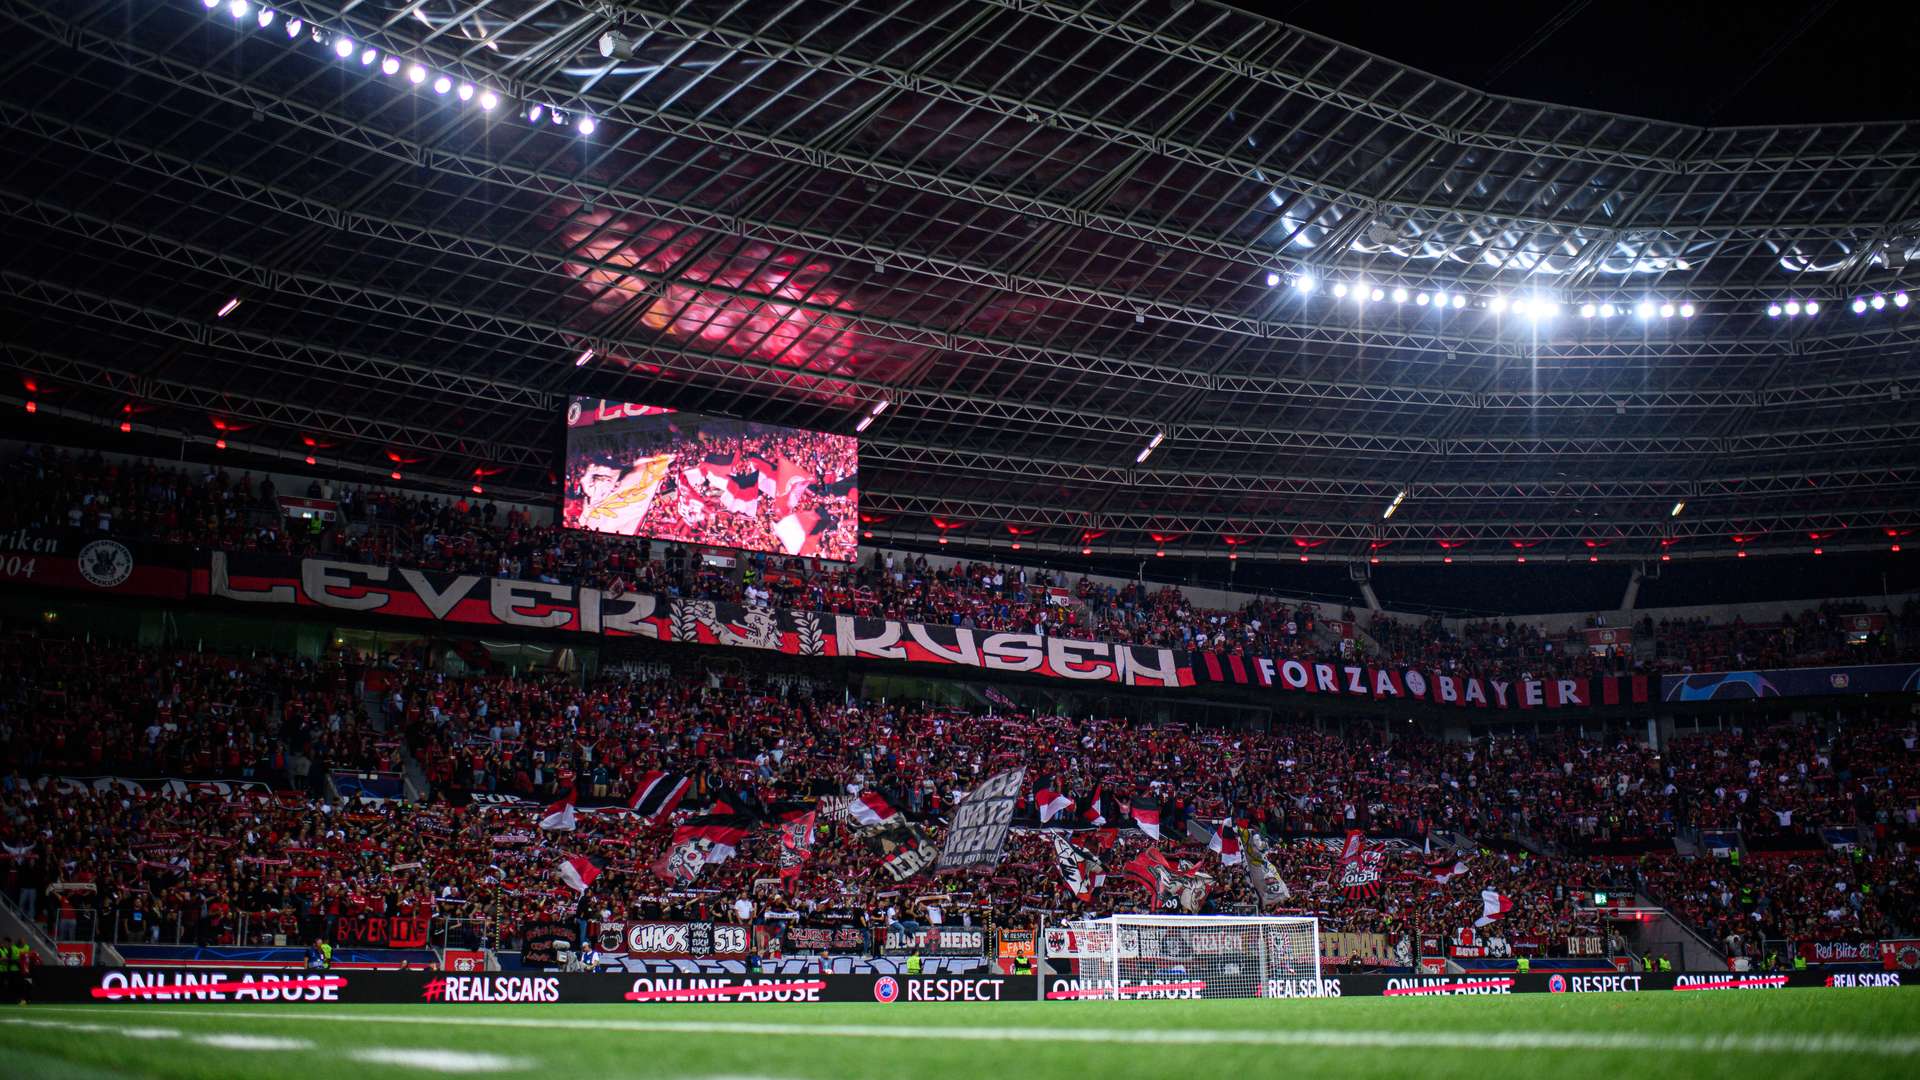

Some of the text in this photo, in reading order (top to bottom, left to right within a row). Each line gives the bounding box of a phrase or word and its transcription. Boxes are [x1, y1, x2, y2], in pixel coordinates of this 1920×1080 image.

[210, 549, 658, 640] LEVER
[1259, 658, 1583, 706] FORZA BAYER
[629, 924, 747, 953] CHAOS 513
[940, 932, 981, 948] HERS
[1814, 942, 1833, 959] Red
[1834, 942, 1857, 960] Blitz
[102, 972, 339, 1001] ONLINE ABUSE
[422, 976, 560, 1002] #REALSCARS
[633, 978, 820, 1002] ONLINE ABUSE
[908, 979, 1004, 1001] RESPECT
[1053, 979, 1202, 1000] ONLINE ABUSE
[1387, 977, 1511, 996] ONLINE ABUSE
[1572, 976, 1641, 992] RESPECT
